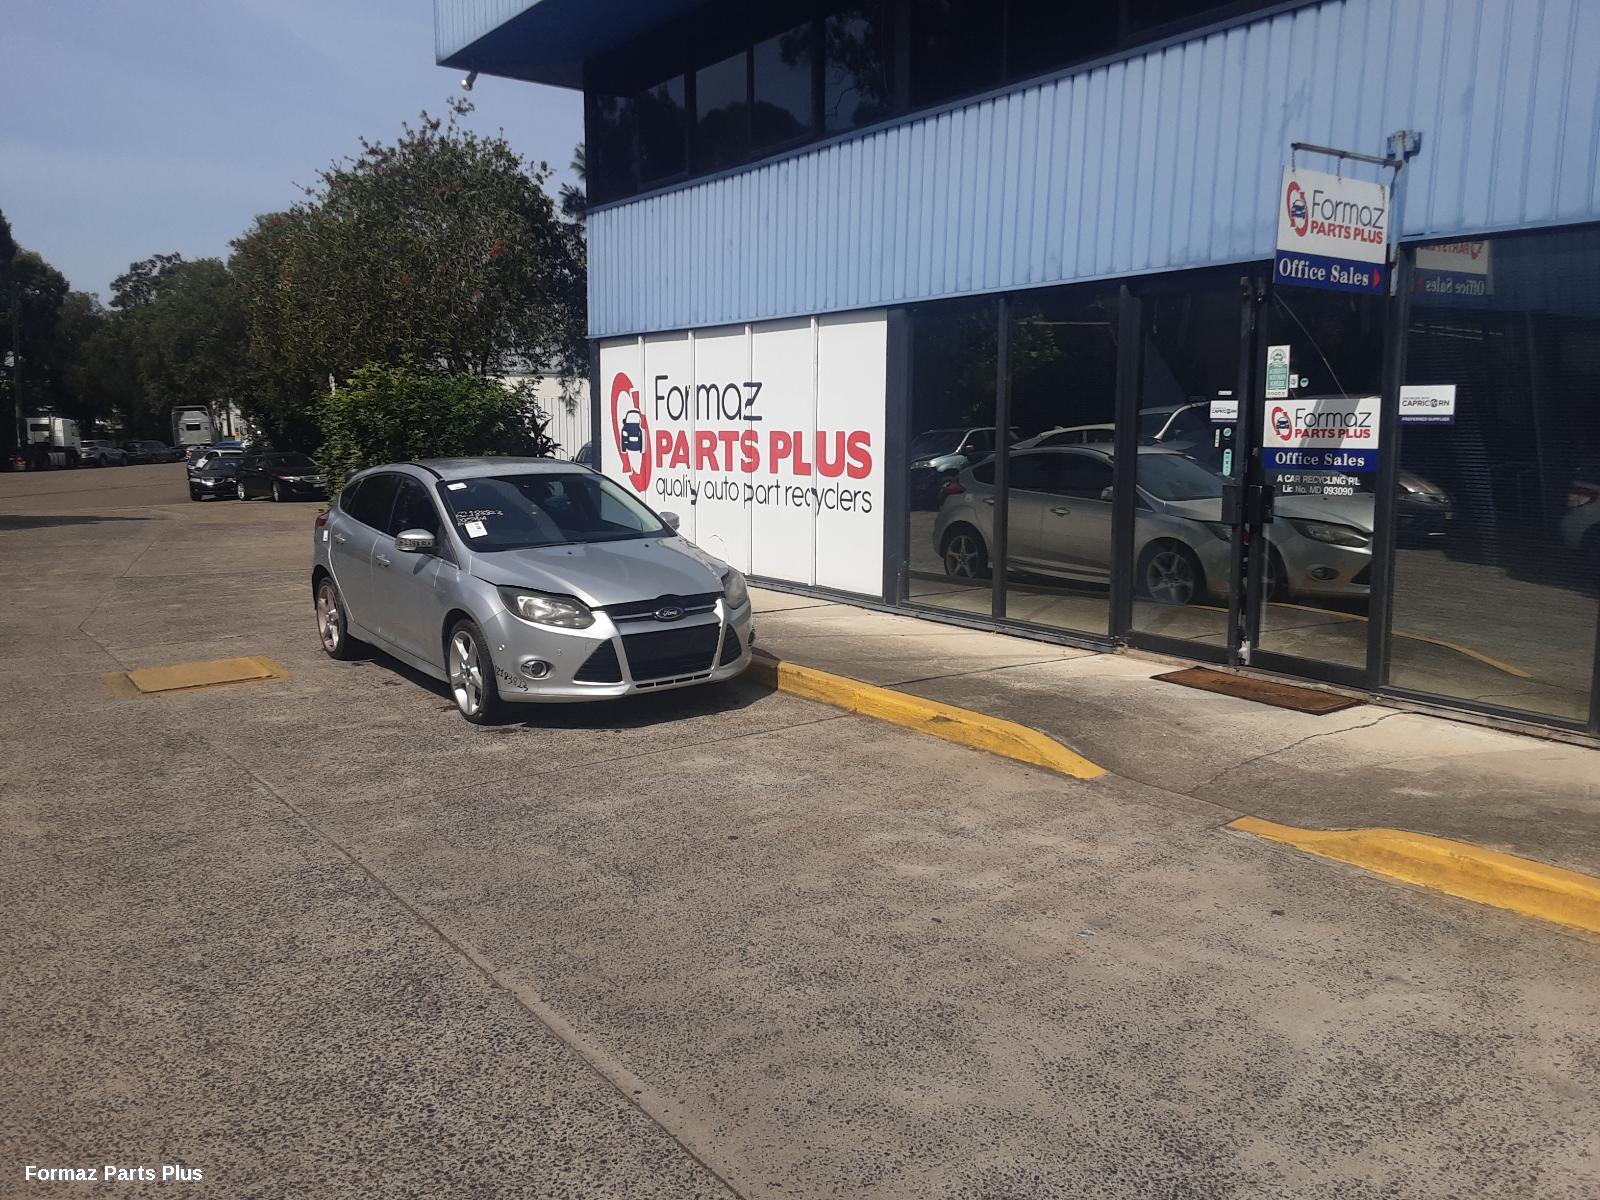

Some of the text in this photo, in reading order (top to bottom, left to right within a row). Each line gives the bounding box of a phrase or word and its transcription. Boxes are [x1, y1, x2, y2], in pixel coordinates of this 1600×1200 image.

[1312, 190, 1385, 229] Formaz
[1310, 220, 1383, 245] PARTS PLUS
[1279, 258, 1369, 286] Office Sales
[655, 375, 763, 421] Formaz
[1295, 408, 1372, 428] Formaz
[1295, 429, 1371, 439] PARTS PLUS
[655, 430, 873, 480] PARTS PLUS
[1275, 451, 1365, 467] Office Sales
[1277, 474, 1283, 483] A
[1284, 474, 1300, 483] CAR
[1302, 475, 1346, 485] RECYCLING
[1309, 486, 1321, 494] MD
[1323, 486, 1353, 495] 093090
[656, 474, 873, 516] qualiy auto part recyclers
